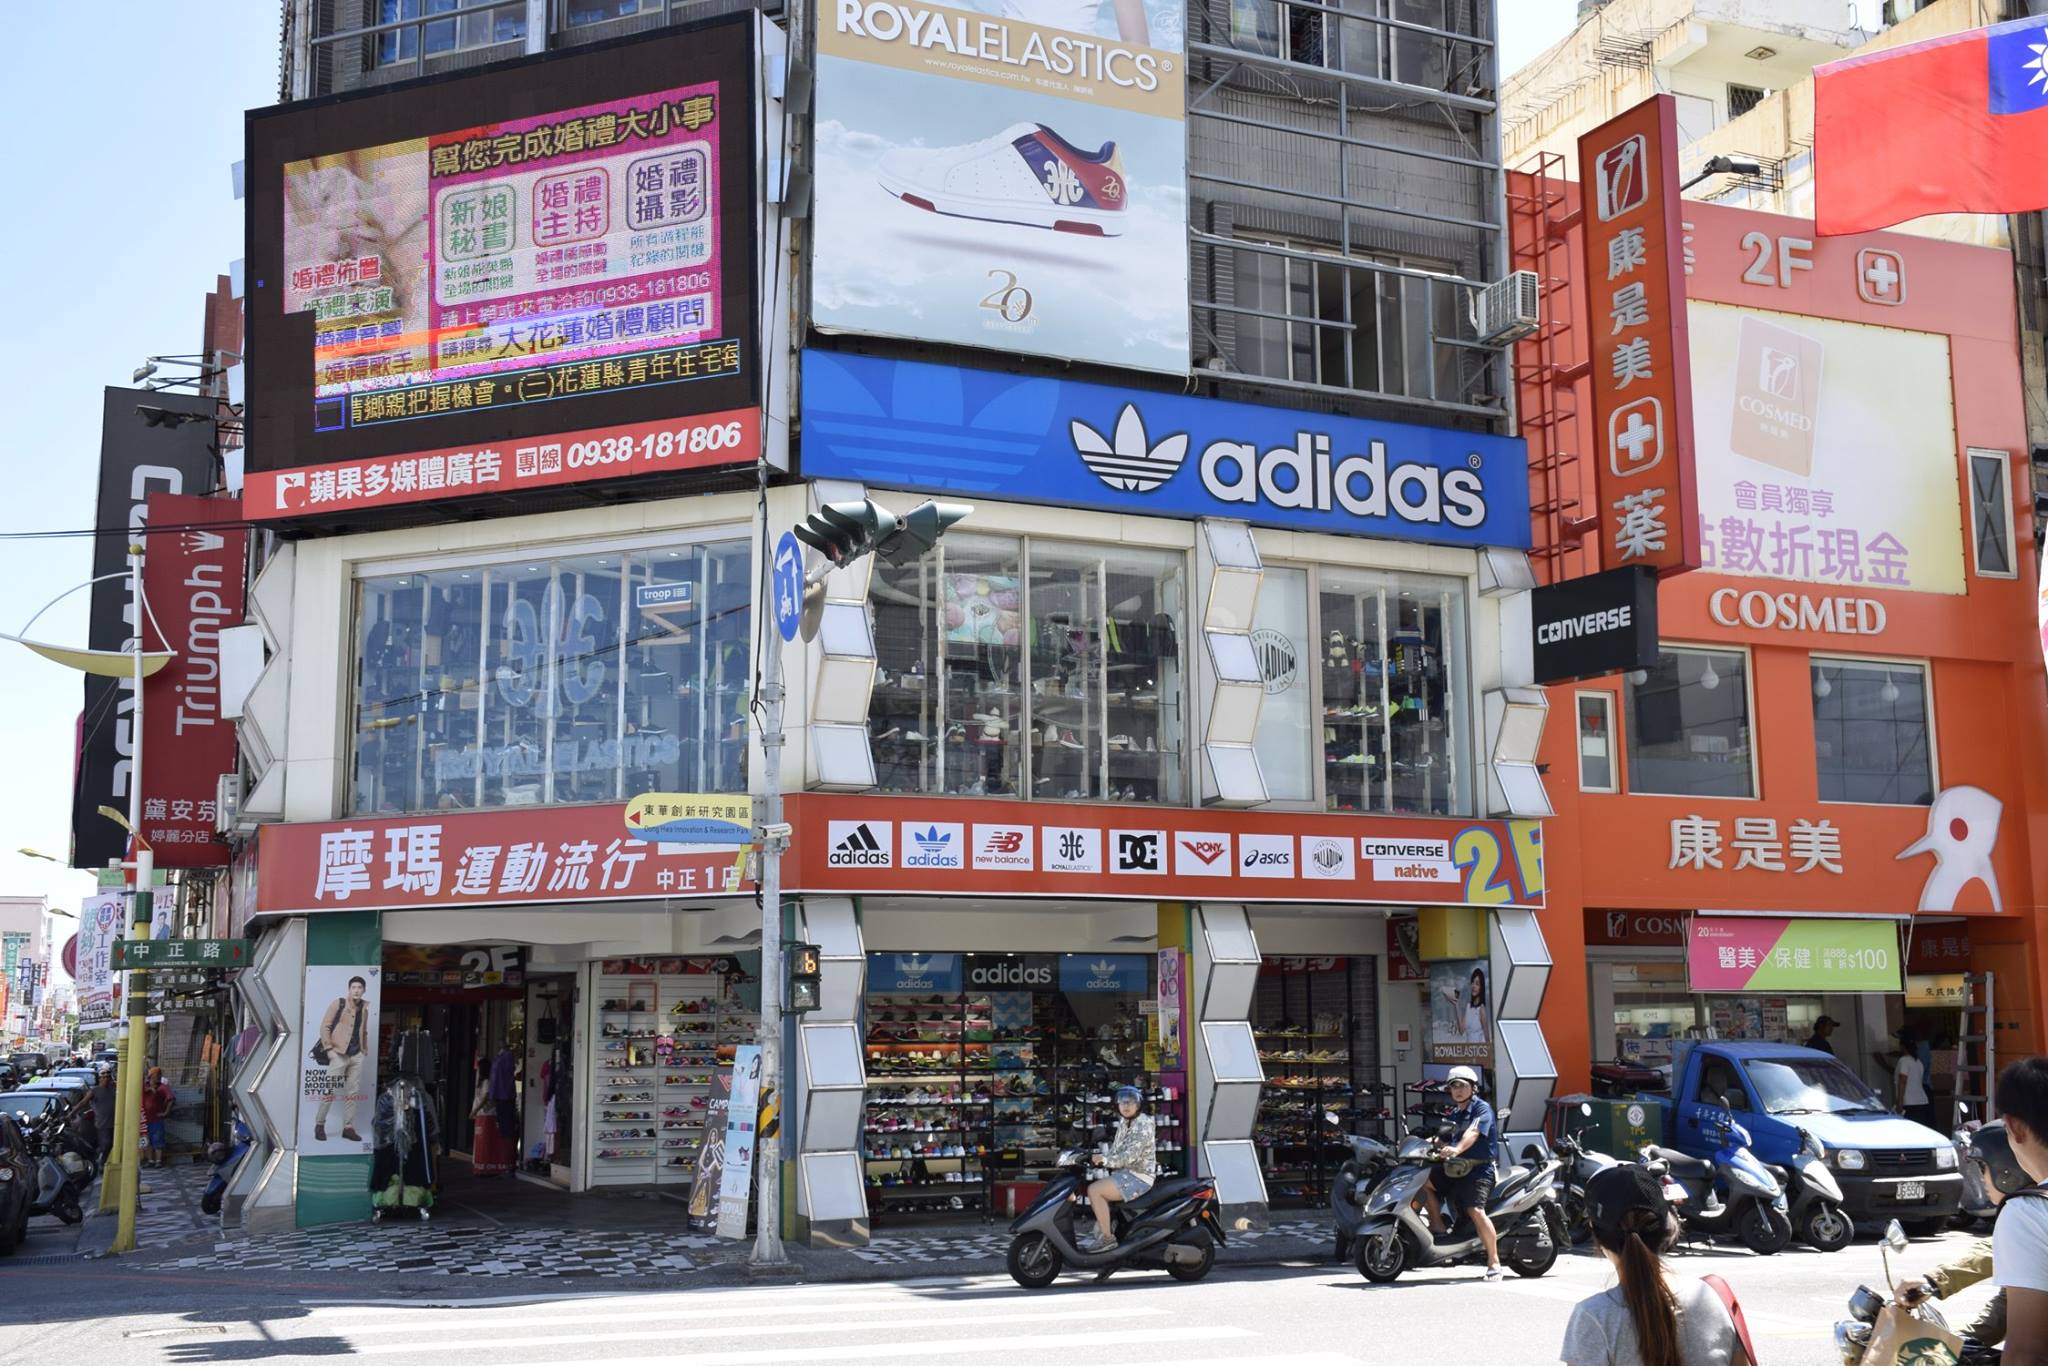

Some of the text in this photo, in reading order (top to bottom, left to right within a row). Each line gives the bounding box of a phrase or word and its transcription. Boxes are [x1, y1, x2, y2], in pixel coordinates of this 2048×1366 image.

[836, 0, 1159, 92] ROYALELASTICS
[924, 58, 1031, 84] www.royalelastics.com.tw
[431, 95, 716, 176] 幫您完成婚禮大小事
[636, 158, 698, 194] 婚禮
[542, 176, 602, 210] 婚禮
[636, 187, 700, 223] 攝影
[450, 194, 508, 226] 新娘
[542, 207, 602, 241] 主持
[450, 222, 508, 255] 秘書
[1741, 231, 1815, 288] 2F
[1607, 226, 1654, 390] 康是美
[499, 297, 706, 353] 大花蓮婚禮顧問
[1740, 395, 1812, 432] COSMED
[309, 421, 743, 504] 蘋果多媒體廣告 專線 0938-181806
[1200, 432, 1487, 527] adidas
[1734, 480, 1835, 518] 會員獨享
[644, 589, 671, 600] troop
[1709, 587, 1887, 635] COSMED
[1537, 604, 1632, 645] CONVERSE
[175, 564, 232, 736] Triumph
[144, 798, 216, 822] 黛安芬
[643, 805, 749, 819] 東華創新研究園區
[643, 825, 660, 834] Dong
[674, 825, 703, 834] Innovation
[709, 826, 736, 834] Research
[736, 826, 749, 835] Park
[1119, 834, 1158, 870] DC
[1196, 841, 1222, 854] PONY
[1365, 843, 1444, 858] CONVERSE
[1667, 814, 1845, 875] 康是美
[314, 825, 648, 900] 摩瑪 運動流行
[829, 849, 889, 866] adidas
[907, 853, 958, 867] adidas
[975, 854, 1030, 865] new balance
[1259, 850, 1290, 866] asics
[1394, 863, 1439, 879] native
[1697, 927, 1709, 937] 20
[133, 942, 221, 959] 中正路
[1718, 946, 1757, 969] 醫美
[1774, 946, 1811, 969] 保健
[1847, 948, 1888, 970] $100
[896, 977, 933, 990] adidas
[971, 962, 1052, 985] adidas
[1086, 977, 1121, 990] adidas
[1434, 1045, 1488, 1058] ROYALELASTICS
[304, 1075, 350, 1083] CONCEPT
[305, 1069, 327, 1077] NOW
[303, 1088, 335, 1096] STYLE
[304, 1082, 345, 1090] MODERN
